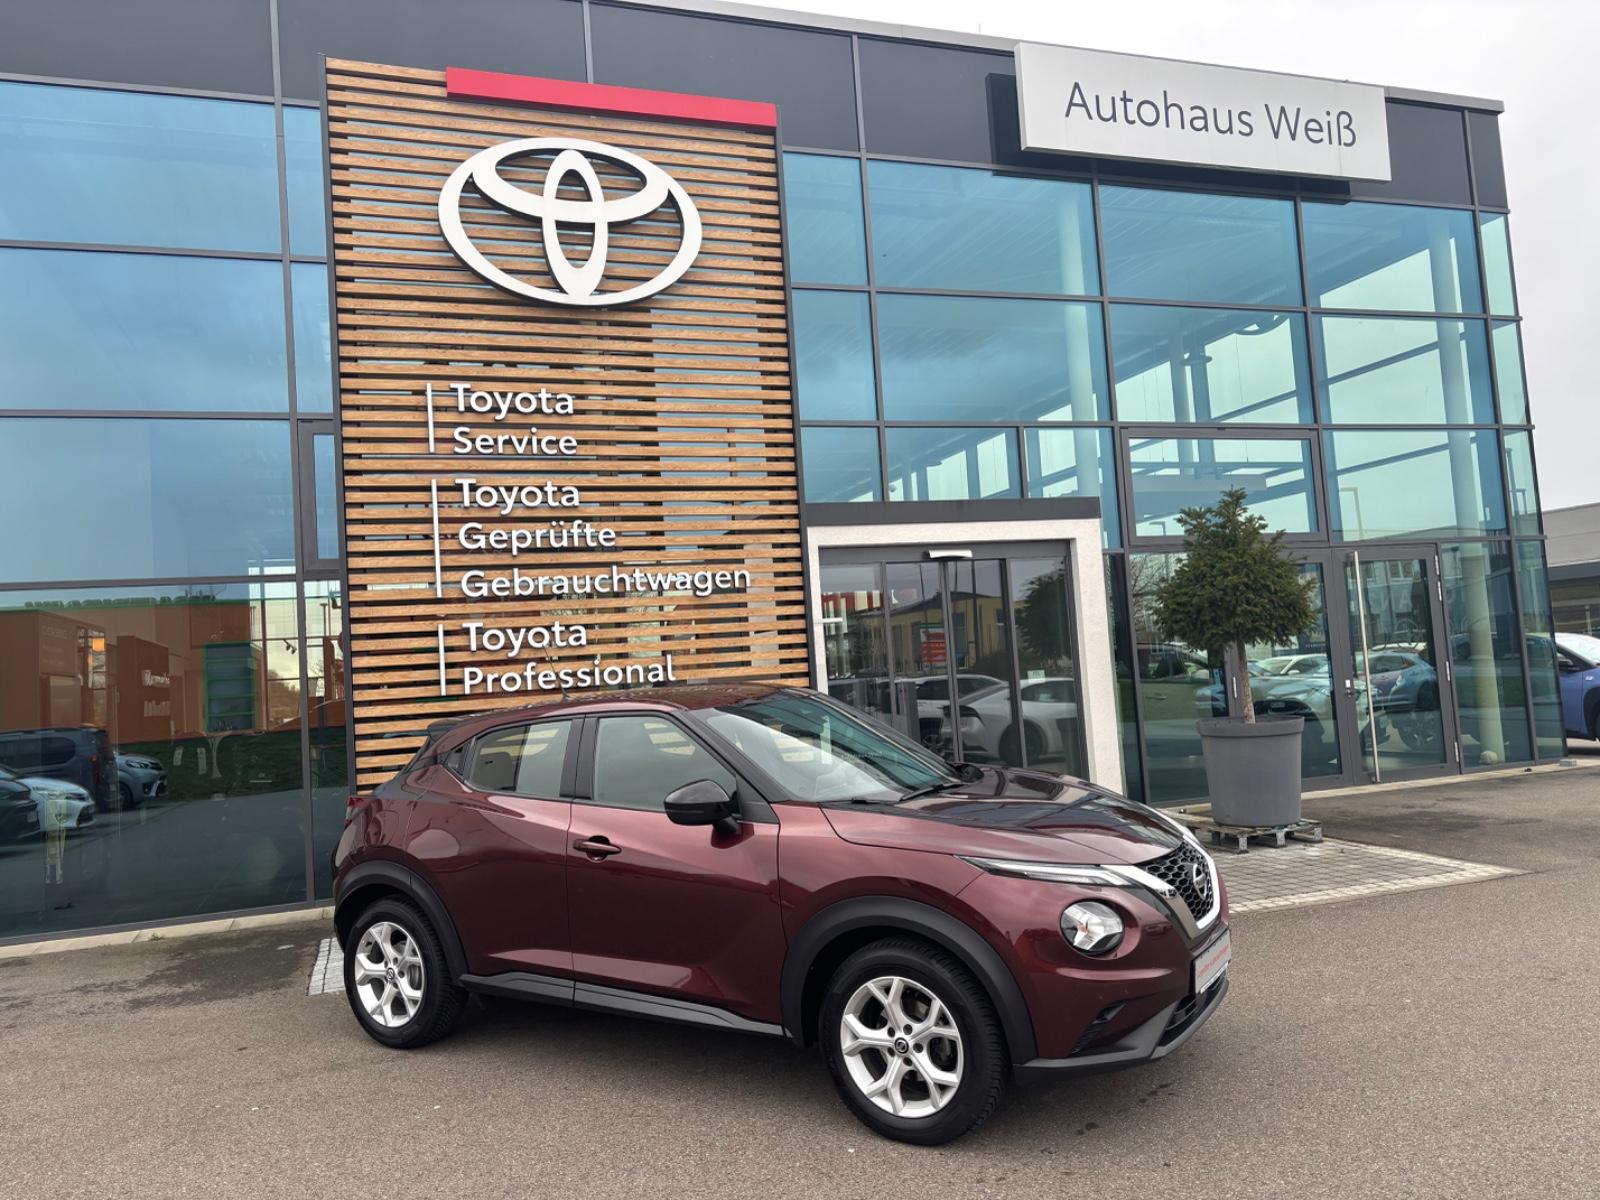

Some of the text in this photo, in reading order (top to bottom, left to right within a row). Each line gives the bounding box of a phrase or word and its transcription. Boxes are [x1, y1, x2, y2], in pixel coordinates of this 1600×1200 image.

[1064, 81, 1357, 148] Autohaus Weiß
[450, 383, 574, 420] Toyota
[452, 427, 578, 454] Service
[455, 478, 580, 515] Toyota
[458, 520, 616, 556] Geprüfte
[461, 565, 750, 598] Gebrauchtwagen
[462, 621, 588, 657] Toyota
[463, 654, 676, 694] Professional
